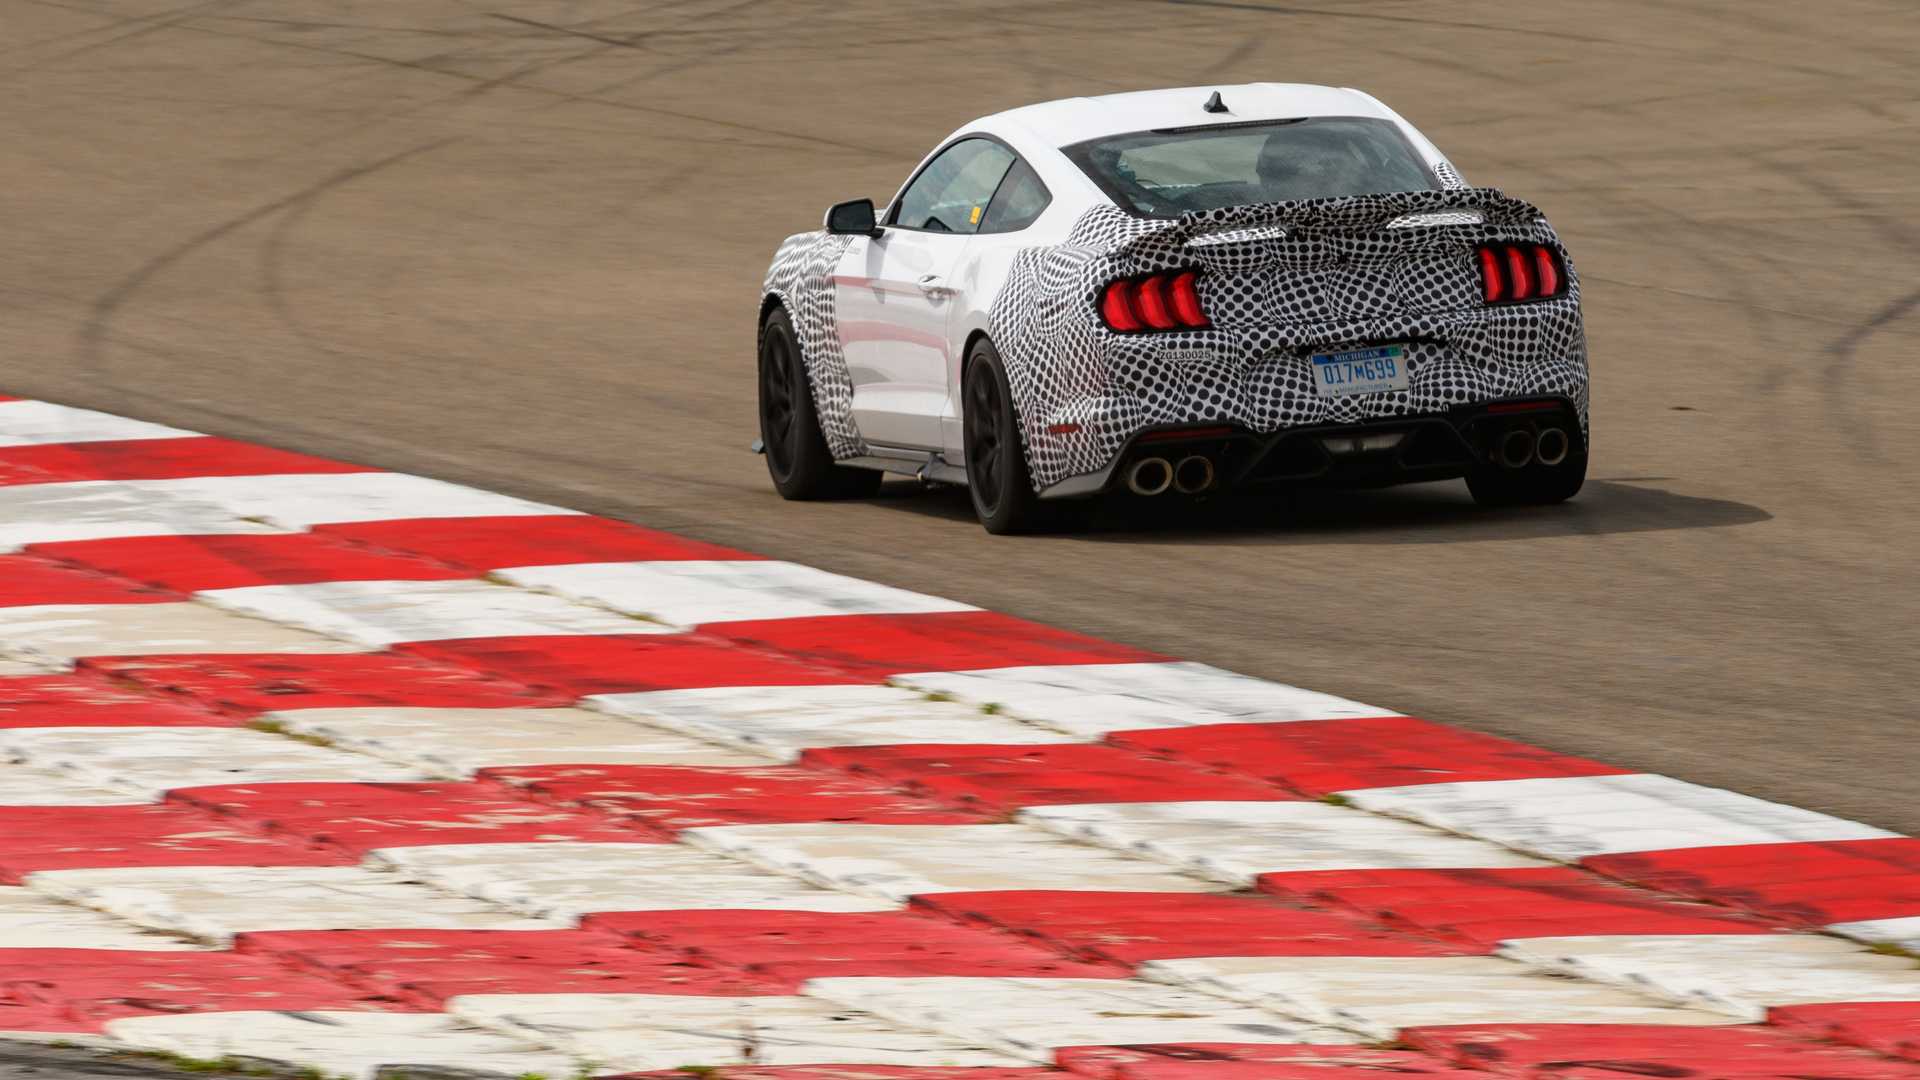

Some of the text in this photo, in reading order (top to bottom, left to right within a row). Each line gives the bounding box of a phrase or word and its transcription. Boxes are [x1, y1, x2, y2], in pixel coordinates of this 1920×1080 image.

[1160, 351, 1211, 360] ZG130025
[1334, 350, 1380, 362] MICHIGAN
[1323, 359, 1396, 384] 017M699
